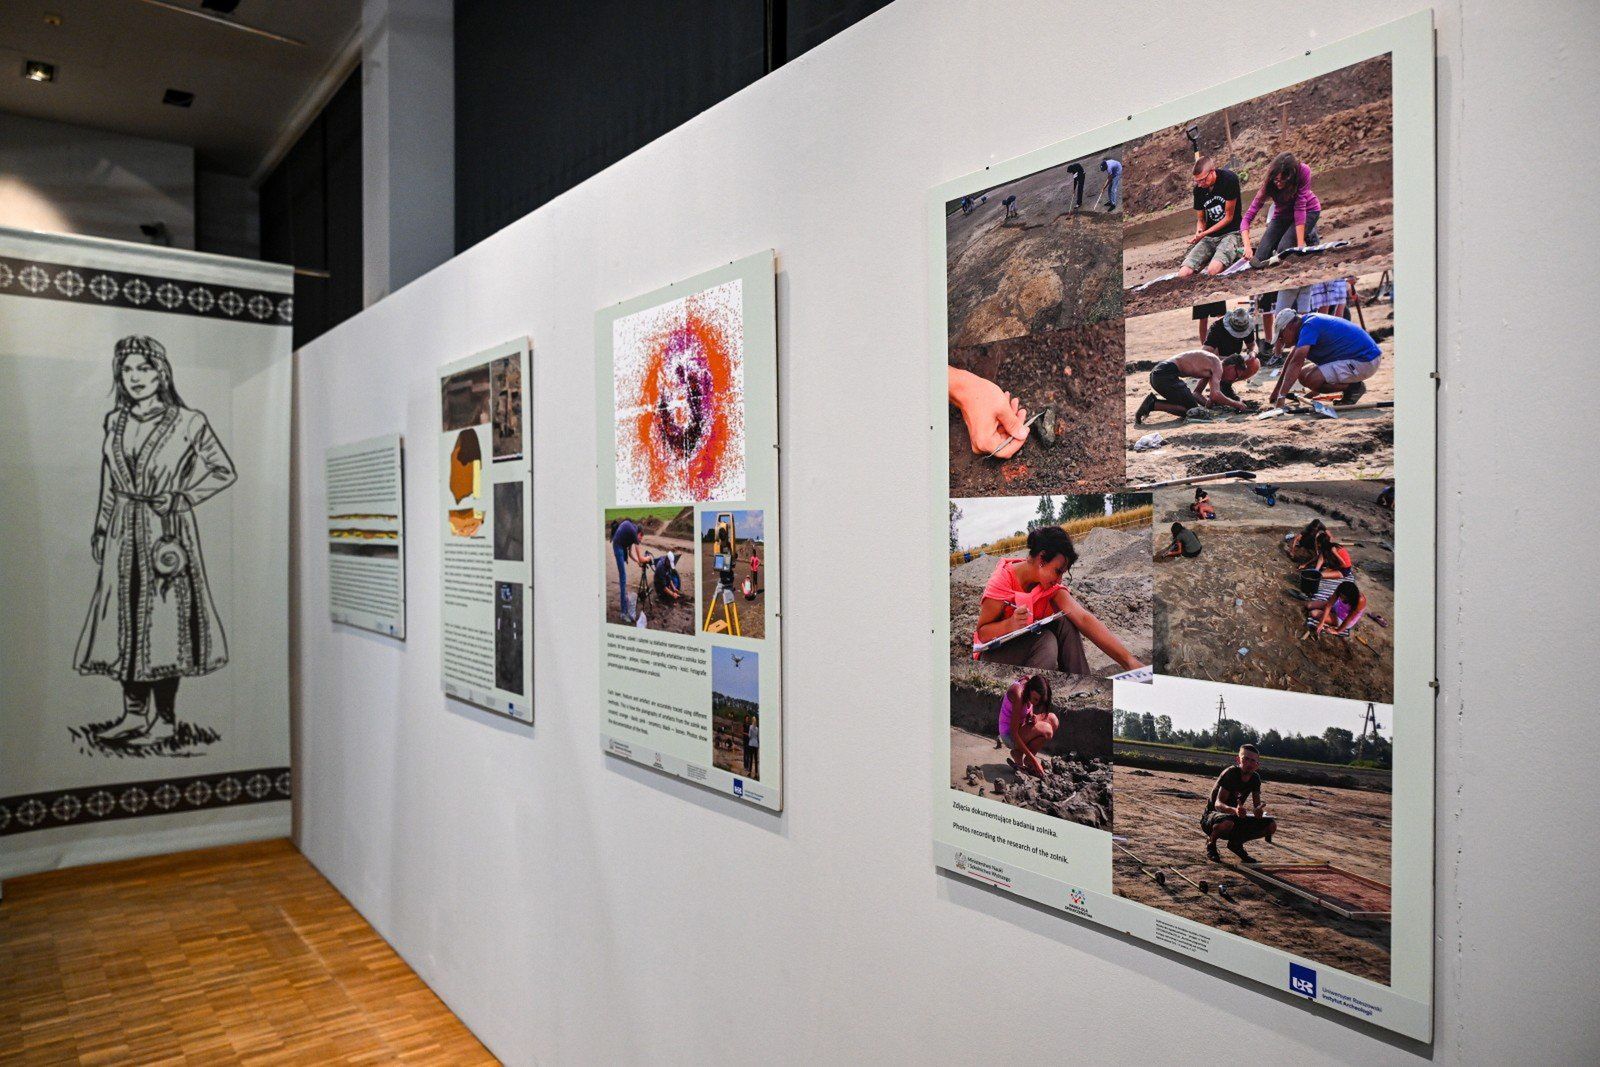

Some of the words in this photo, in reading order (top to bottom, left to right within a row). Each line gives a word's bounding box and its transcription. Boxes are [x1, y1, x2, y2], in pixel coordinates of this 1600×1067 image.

[952, 801, 971, 812] Zdjęcia
[971, 807, 1012, 824] dokumentujące
[1012, 818, 1035, 831] badania
[1036, 827, 1058, 838] zolnika.
[952, 822, 970, 833] Photos
[971, 827, 996, 842] recording
[996, 835, 1006, 845] the
[1006, 840, 1031, 852] research
[1038, 849, 1049, 858] the
[1050, 854, 1069, 864] zolnik.
